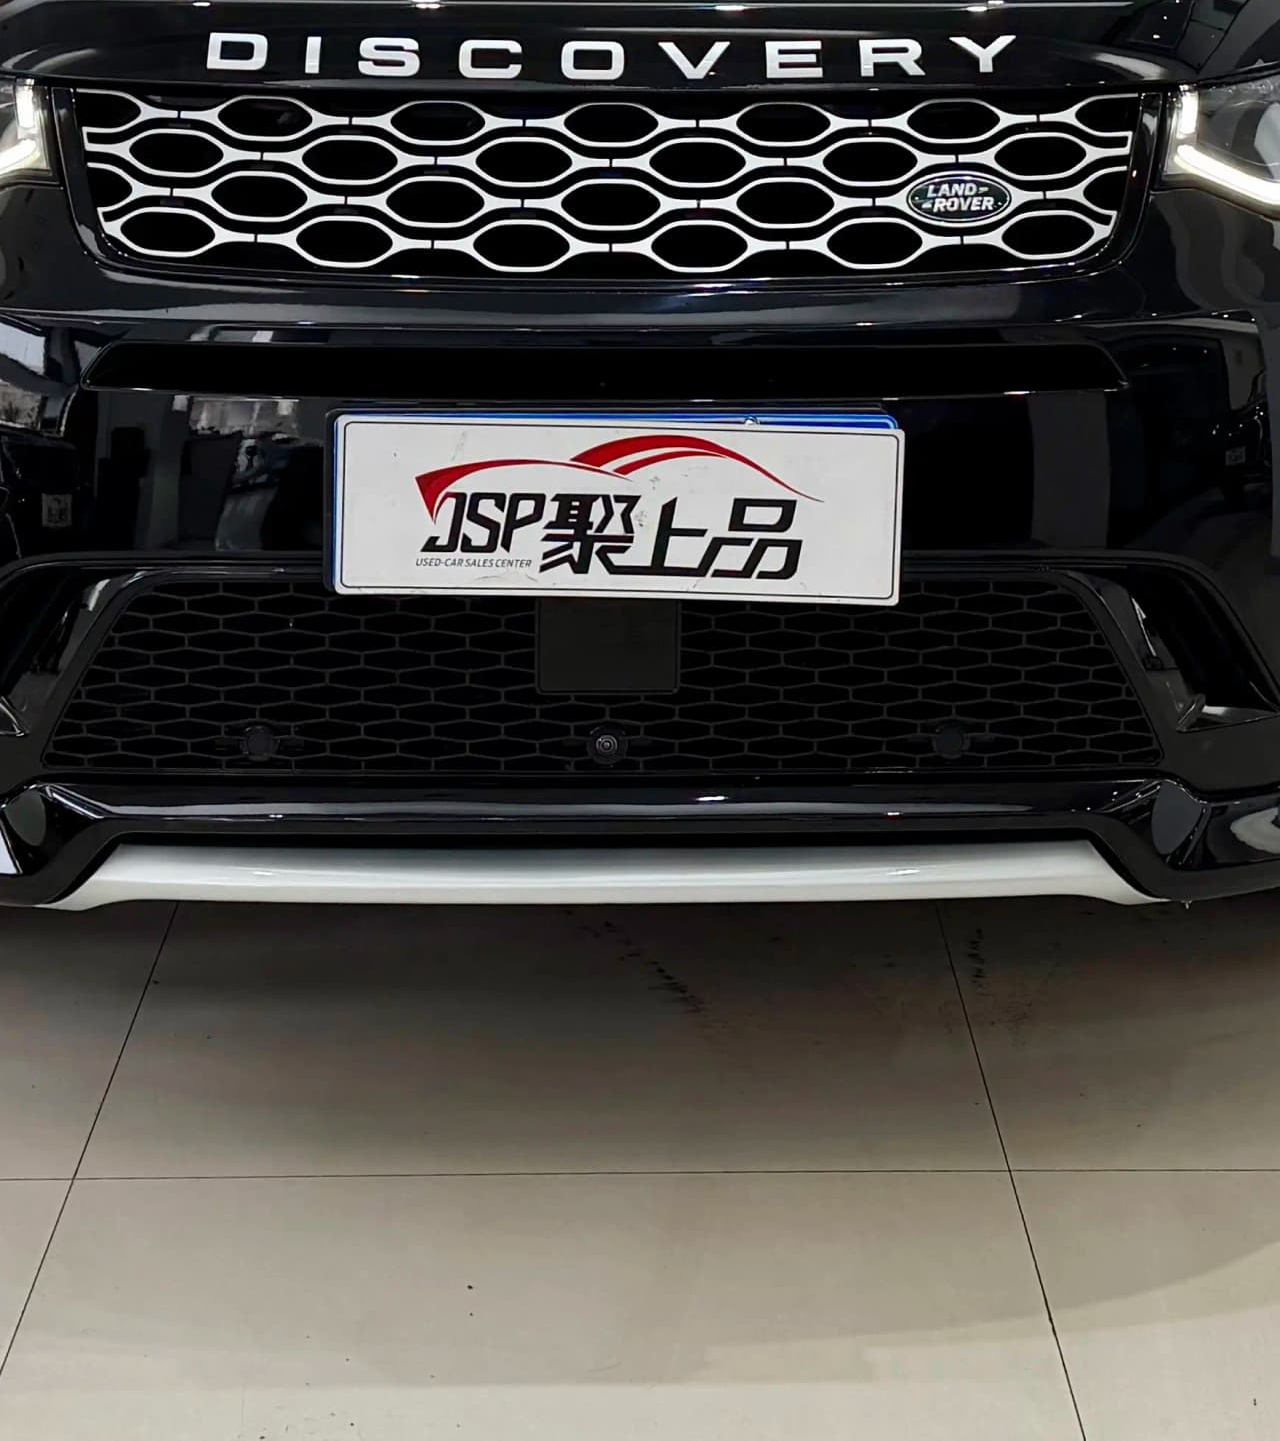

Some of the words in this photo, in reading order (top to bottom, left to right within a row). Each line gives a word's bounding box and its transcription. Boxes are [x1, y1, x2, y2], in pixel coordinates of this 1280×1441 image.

[206, 31, 1017, 81] DISCOVERY
[927, 182, 977, 198] LAND
[932, 196, 995, 213] ROVER
[415, 557, 463, 567] USED-CAR
[464, 558, 494, 568] SALES
[495, 559, 532, 568] CENTER
